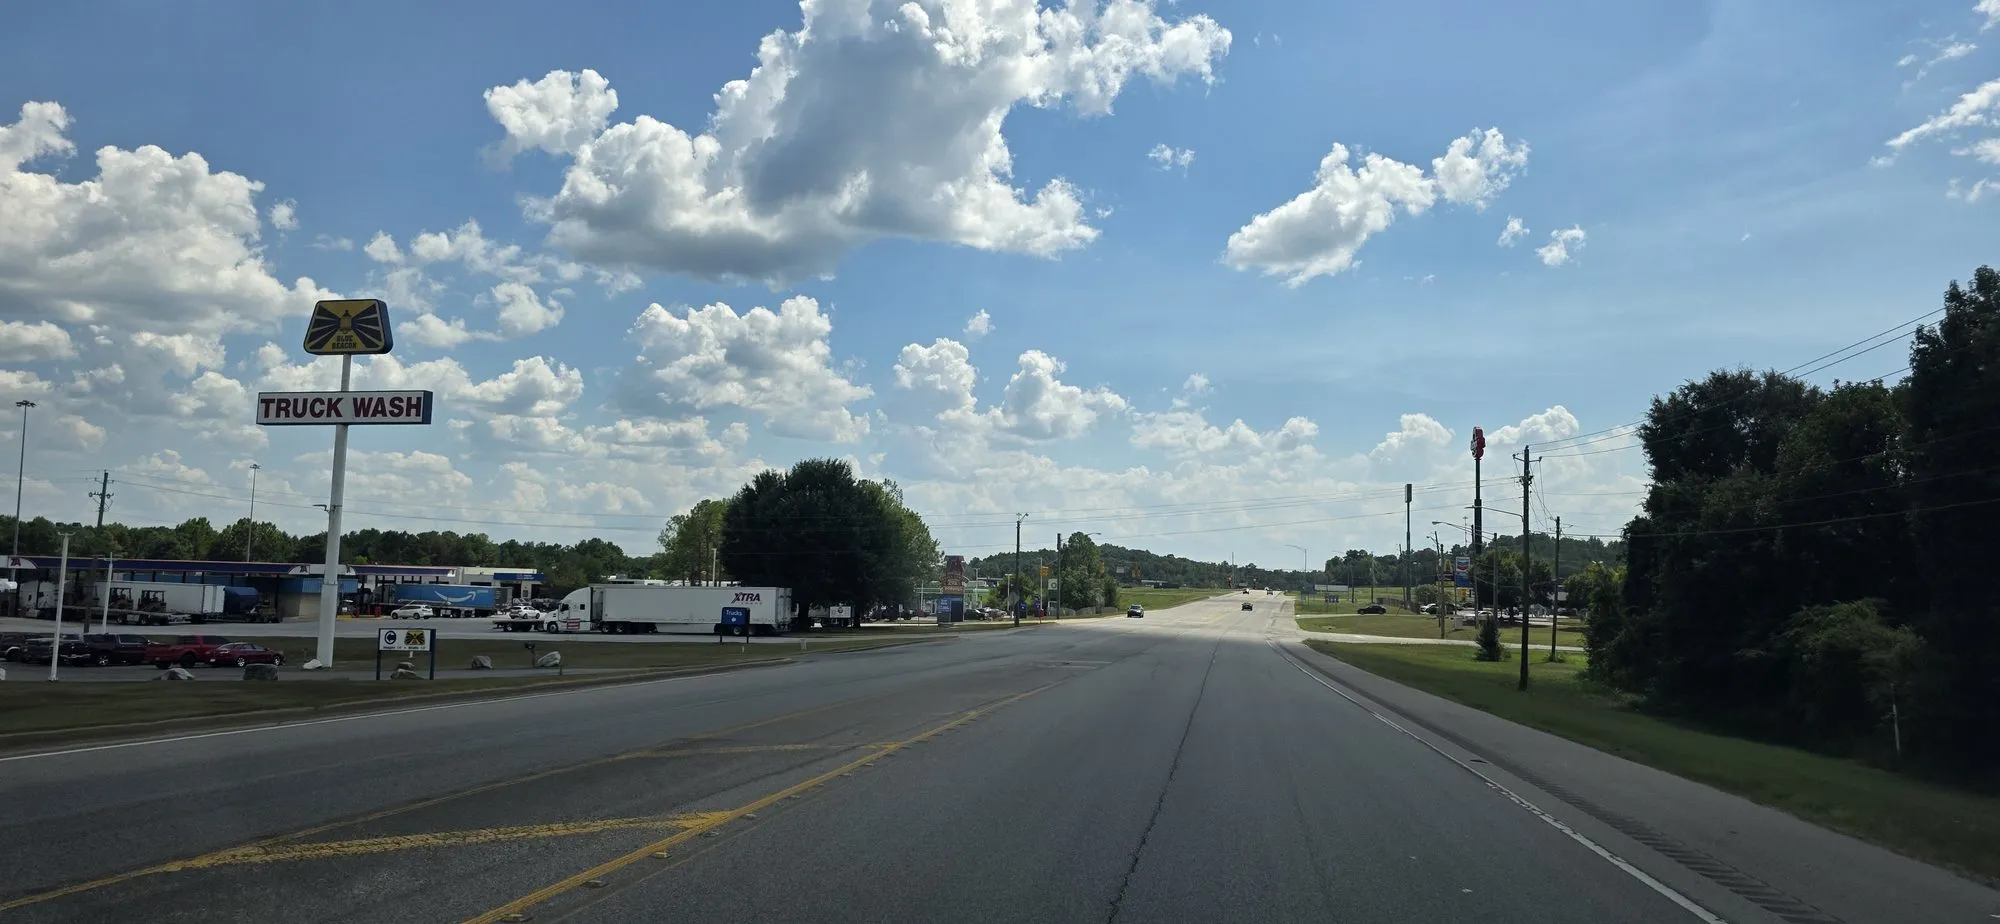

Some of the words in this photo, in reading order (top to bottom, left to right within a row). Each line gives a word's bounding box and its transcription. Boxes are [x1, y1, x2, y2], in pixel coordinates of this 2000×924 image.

[260, 397, 344, 419] TRUCK
[353, 396, 422, 418] WASH
[731, 592, 761, 603] XTRA
